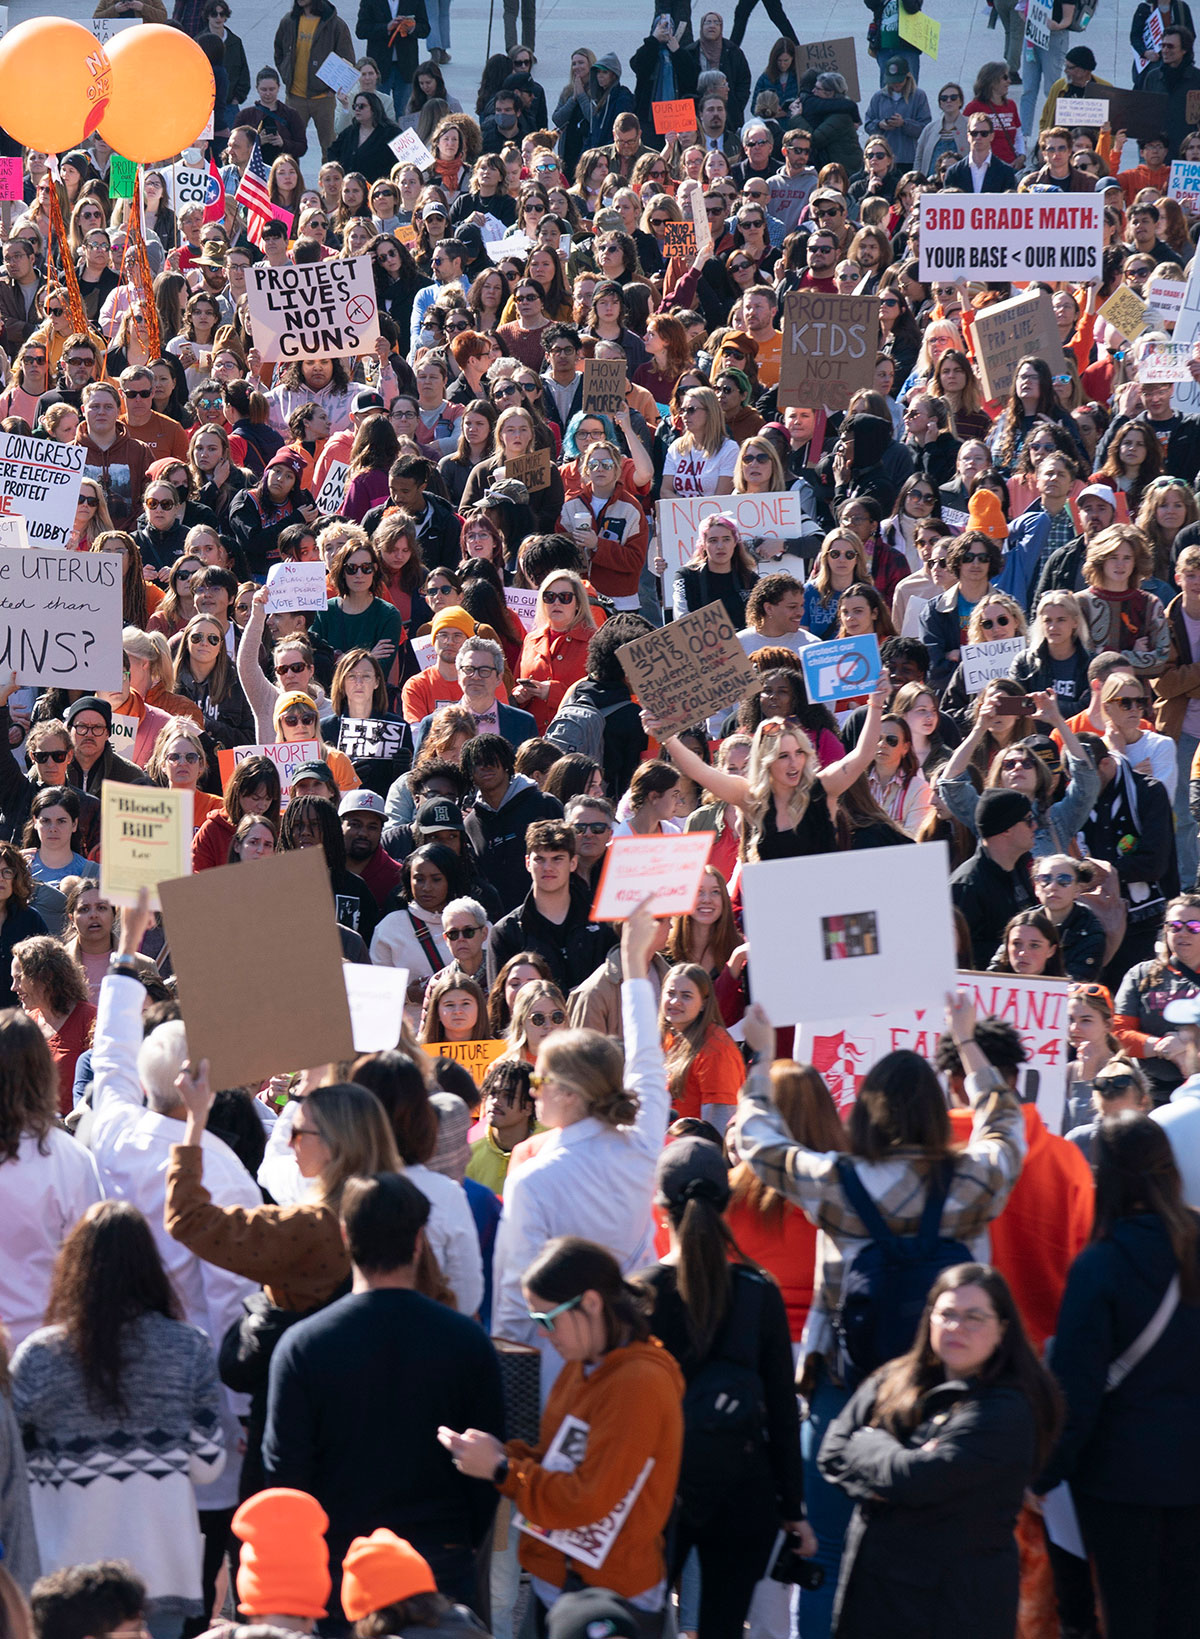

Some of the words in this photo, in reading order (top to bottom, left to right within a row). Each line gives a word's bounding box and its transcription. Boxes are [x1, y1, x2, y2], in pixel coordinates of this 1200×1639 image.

[94, 19, 109, 31] WE
[787, 189, 806, 199] RED
[925, 209, 965, 230] 3RD
[971, 208, 1034, 230] GRADE
[1039, 207, 1099, 230] MATH:
[925, 247, 965, 269] YOUR
[970, 246, 1008, 268] BASE
[1025, 246, 1057, 268] OUR
[1060, 246, 1097, 268] KIDS
[254, 259, 357, 290] PROTECT
[266, 281, 350, 311] LIVES
[284, 306, 337, 331] NOT
[787, 296, 879, 323] PROTECT
[280, 325, 360, 357] GUNS
[791, 322, 867, 359] KIDS
[591, 364, 620, 377] HOW
[805, 360, 849, 380] NOT
[589, 379, 620, 393] MANY
[586, 394, 622, 413] MORE?
[5, 434, 84, 471] CONGRESS
[19, 466, 71, 486] ELECTED
[676, 459, 706, 476] BAN
[3, 479, 50, 502] PROTECT
[674, 476, 704, 493] BAN
[736, 497, 796, 529] ONE
[29, 519, 71, 542] LOBBY
[21, 556, 119, 587] UTERUS'
[42, 597, 100, 613] than
[271, 599, 294, 609] VOTE
[298, 592, 325, 608] BLUE!
[629, 628, 673, 662] MORE
[679, 606, 724, 639] THAN
[698, 648, 728, 665] have
[806, 645, 838, 659] protect
[839, 642, 855, 652] our
[807, 654, 844, 667] children
[965, 639, 1022, 661] ENOUGH
[642, 673, 699, 702] experienced
[343, 719, 401, 741] IT'S
[264, 743, 310, 764] MORE
[434, 806, 450, 822] H
[131, 848, 151, 859] Lee
[440, 1043, 491, 1061] FUTURE
